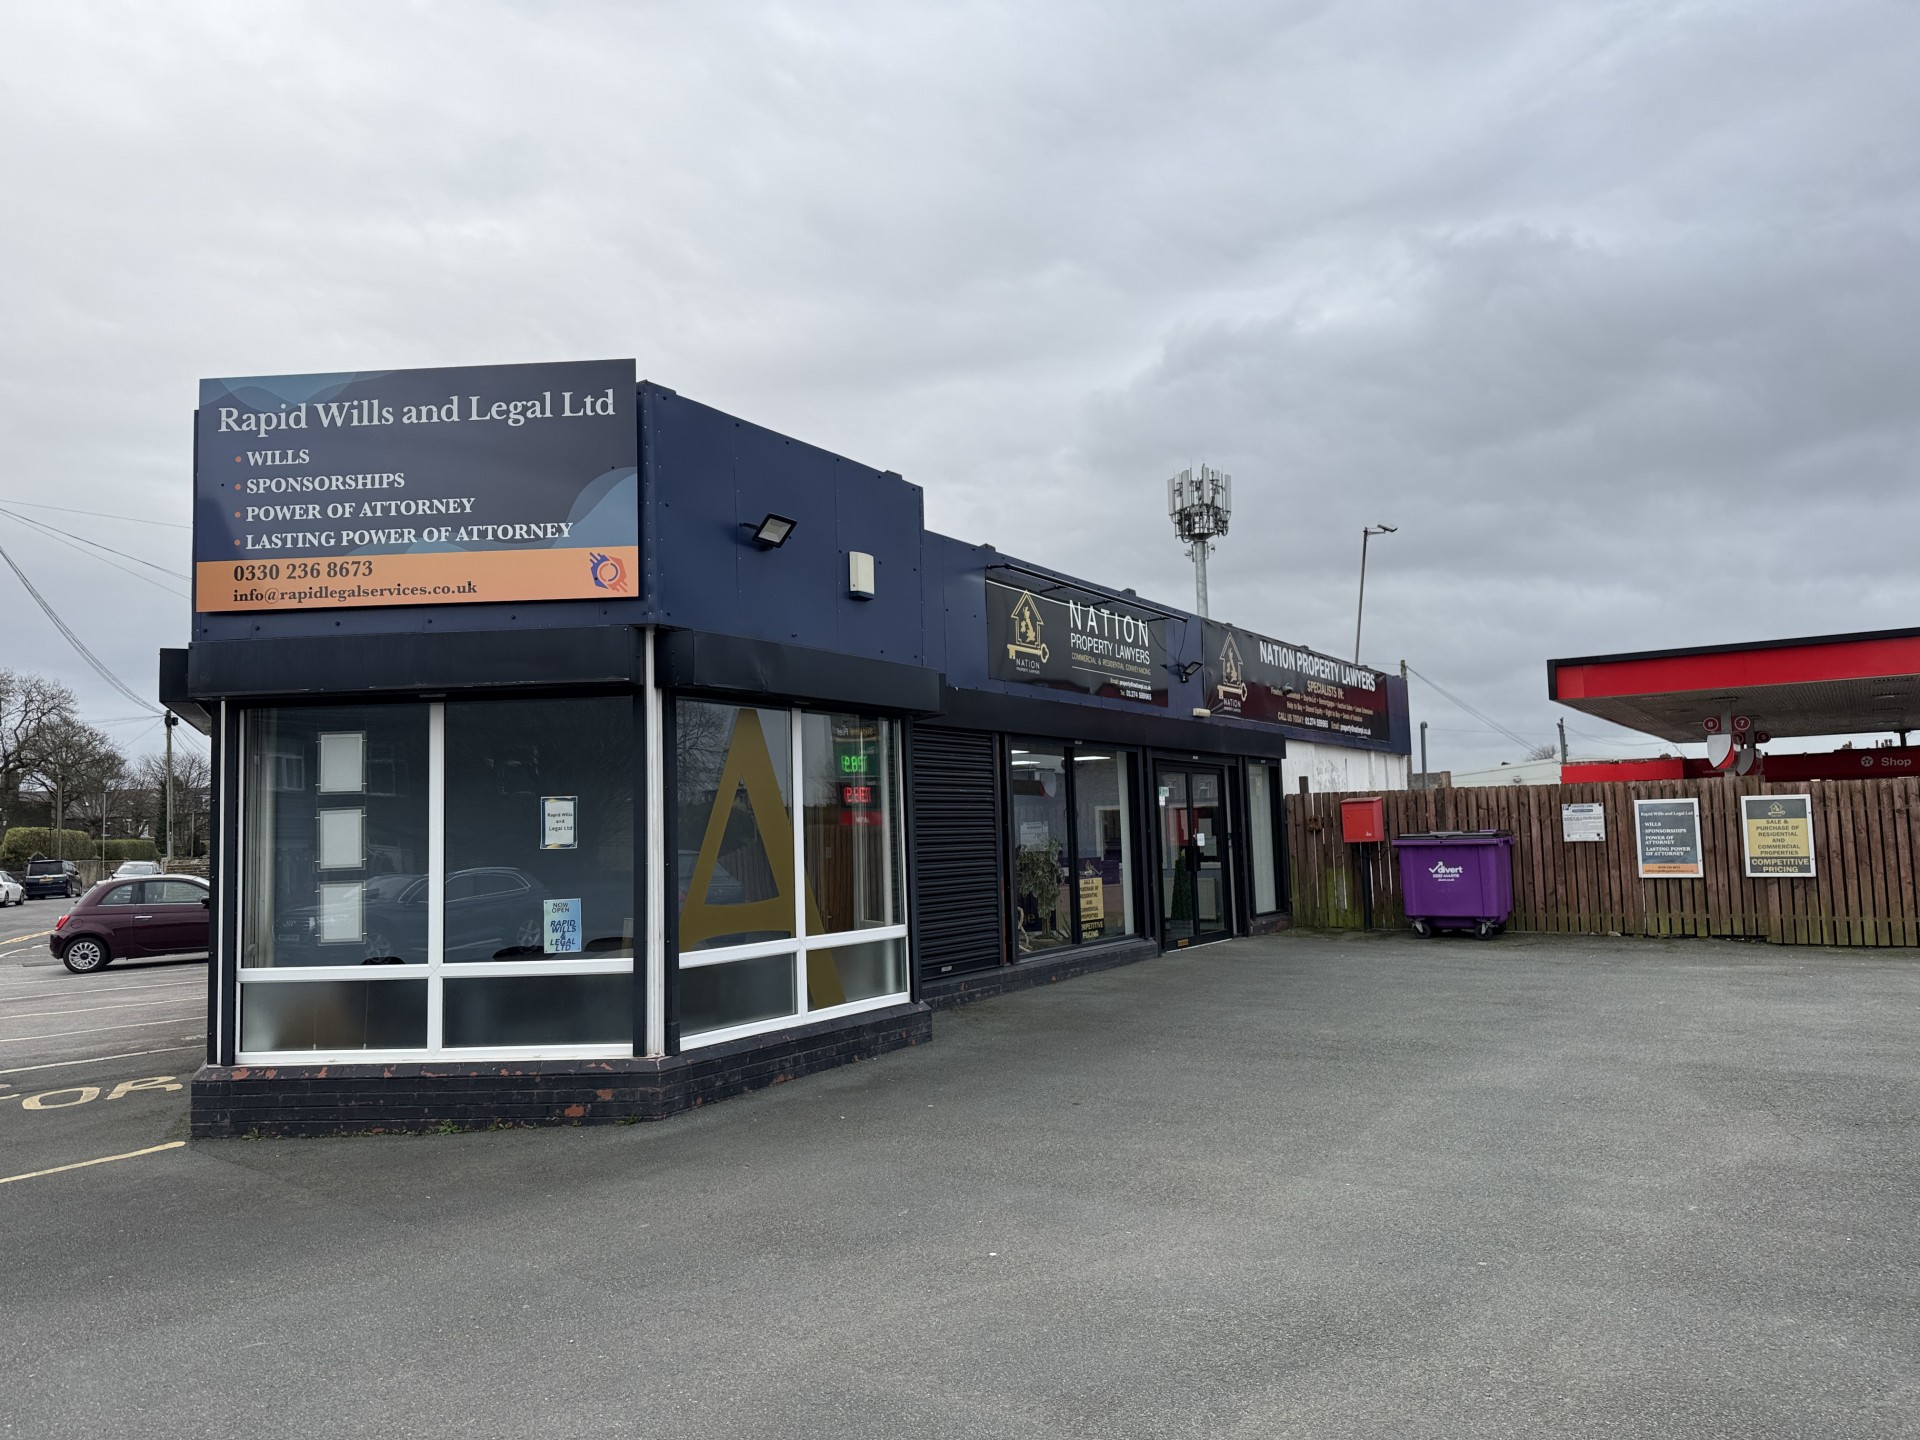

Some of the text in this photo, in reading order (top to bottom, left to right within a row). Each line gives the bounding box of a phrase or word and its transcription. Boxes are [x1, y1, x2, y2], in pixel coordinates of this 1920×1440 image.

[217, 388, 616, 438] Rapid Wills and Legal Ltd
[246, 449, 310, 466] WILLS
[246, 473, 405, 494] SPONSORSHIPS
[245, 498, 475, 521] POWER OF ATTORNEY
[245, 522, 573, 550] LASTING POWER OF ATTORNEY
[233, 560, 373, 582] 0330 236 8673
[233, 581, 477, 604] info@rapidlegalservices.co.uk
[1069, 600, 1149, 647] NATION
[1070, 632, 1150, 665] PROPERTY LAWYERS
[1016, 658, 1040, 669] NATION
[1259, 640, 1376, 692] NATION PROPERTY LAWYERS
[1307, 680, 1337, 698] SPECIALISTS
[1881, 757, 1912, 767] Shop
[1751, 858, 1810, 866] COMPETITIVE
[550, 919, 576, 927] RAPID
[550, 938, 576, 946] LEGAL
